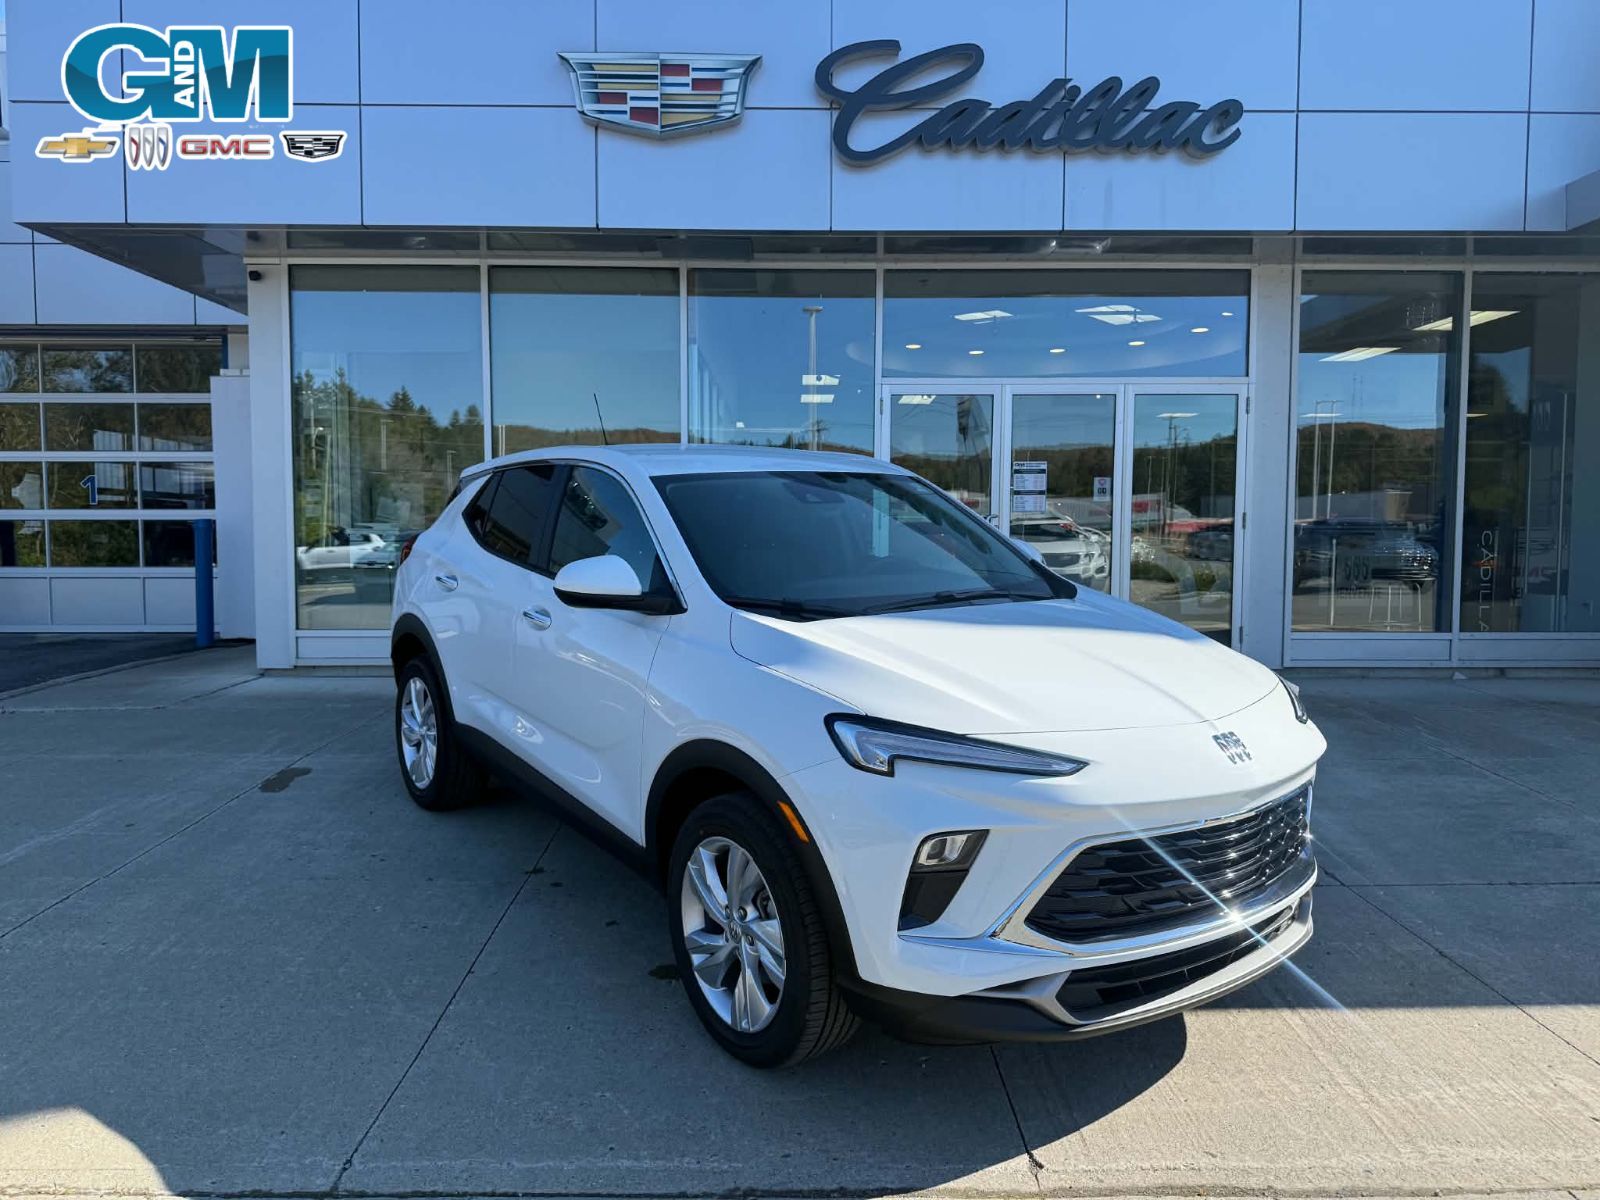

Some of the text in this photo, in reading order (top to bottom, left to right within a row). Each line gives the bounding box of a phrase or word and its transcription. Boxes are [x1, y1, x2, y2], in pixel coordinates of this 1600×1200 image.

[815, 39, 1244, 167] Cadillac
[81, 475, 97, 505] 1
[1478, 530, 1493, 632] CADILLA
